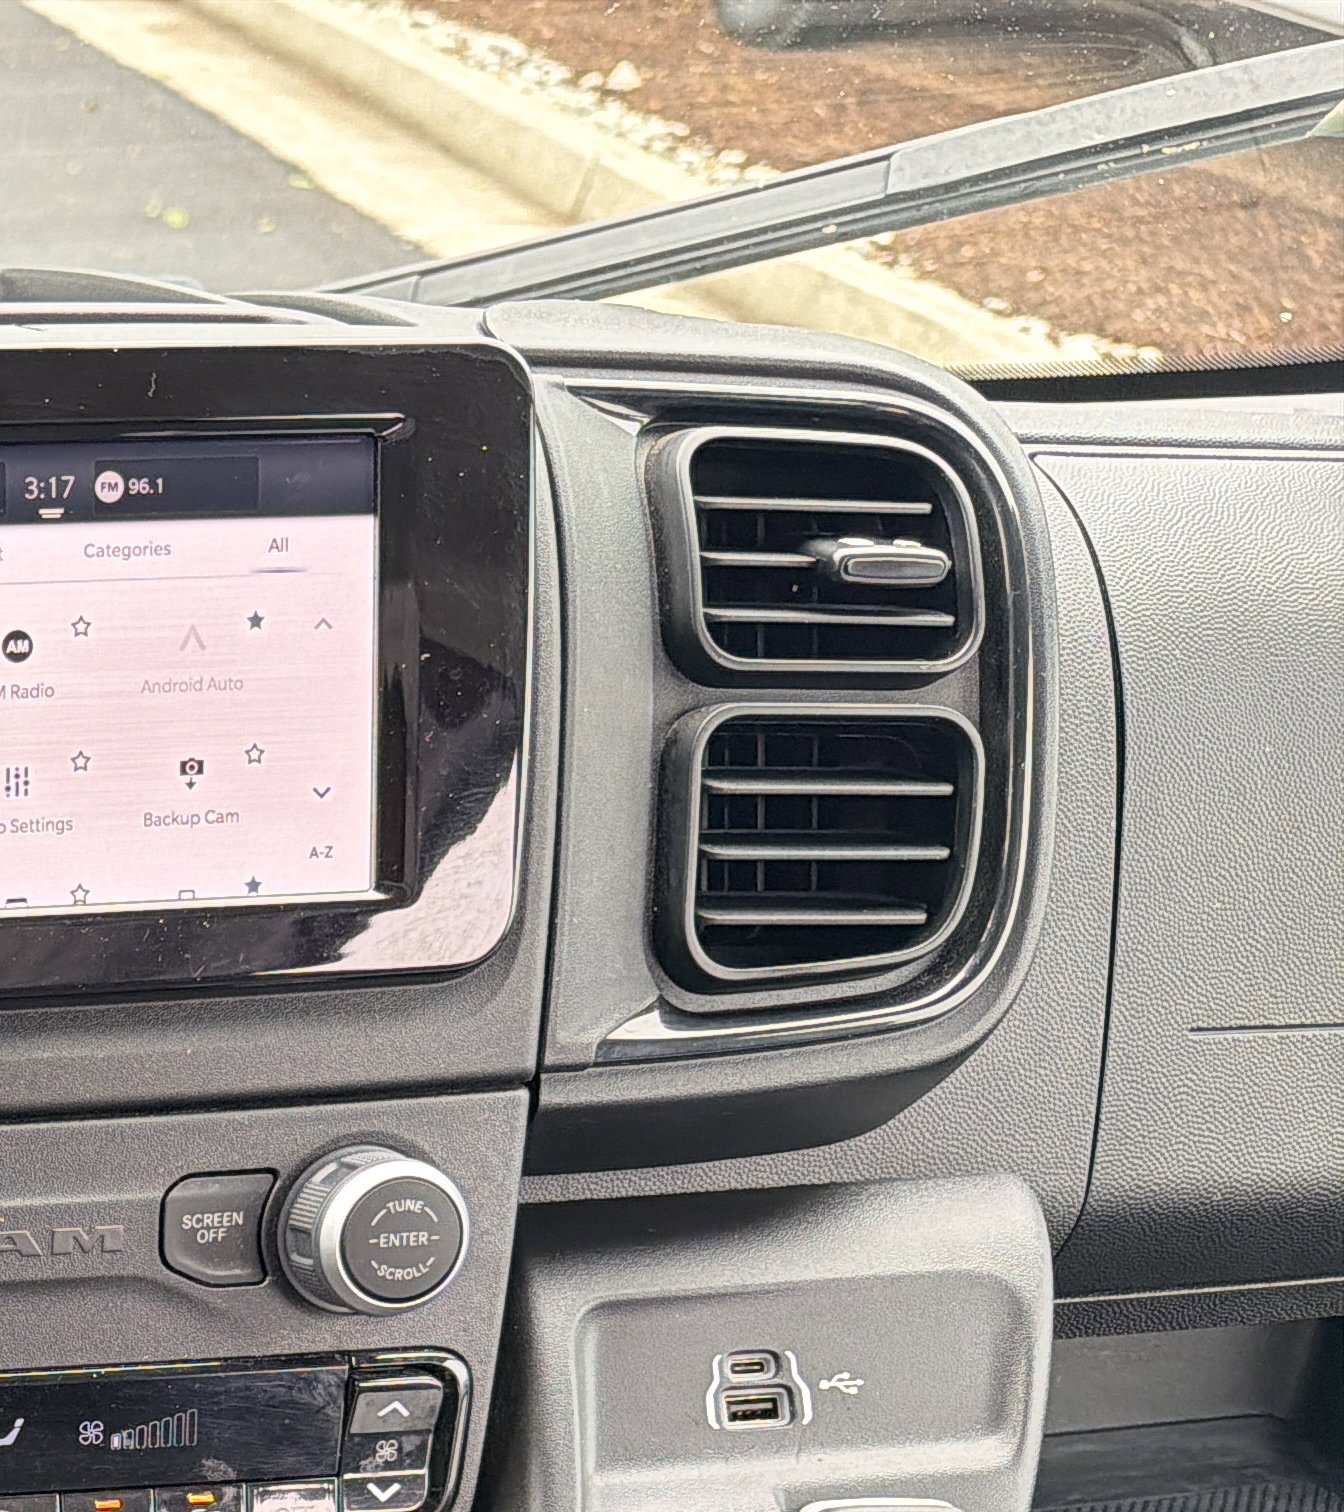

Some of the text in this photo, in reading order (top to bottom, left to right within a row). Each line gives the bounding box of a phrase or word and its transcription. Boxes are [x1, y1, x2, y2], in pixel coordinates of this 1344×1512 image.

[24, 476, 76, 499] 3:17
[100, 478, 164, 496] FM 96.1
[83, 540, 172, 561] Categories
[267, 538, 290, 554] All
[6, 640, 30, 654] AM
[11, 682, 55, 699] Radio
[141, 677, 244, 694] Android Auto
[11, 816, 74, 836] Settings
[143, 808, 240, 829] Backup Cam
[309, 844, 334, 860] A-Z
[386, 1199, 424, 1214] TUNE
[182, 1211, 244, 1229] SCREEN
[196, 1227, 227, 1244] OFF
[379, 1232, 428, 1248] ENTER
[377, 1262, 430, 1281] SCROLL
